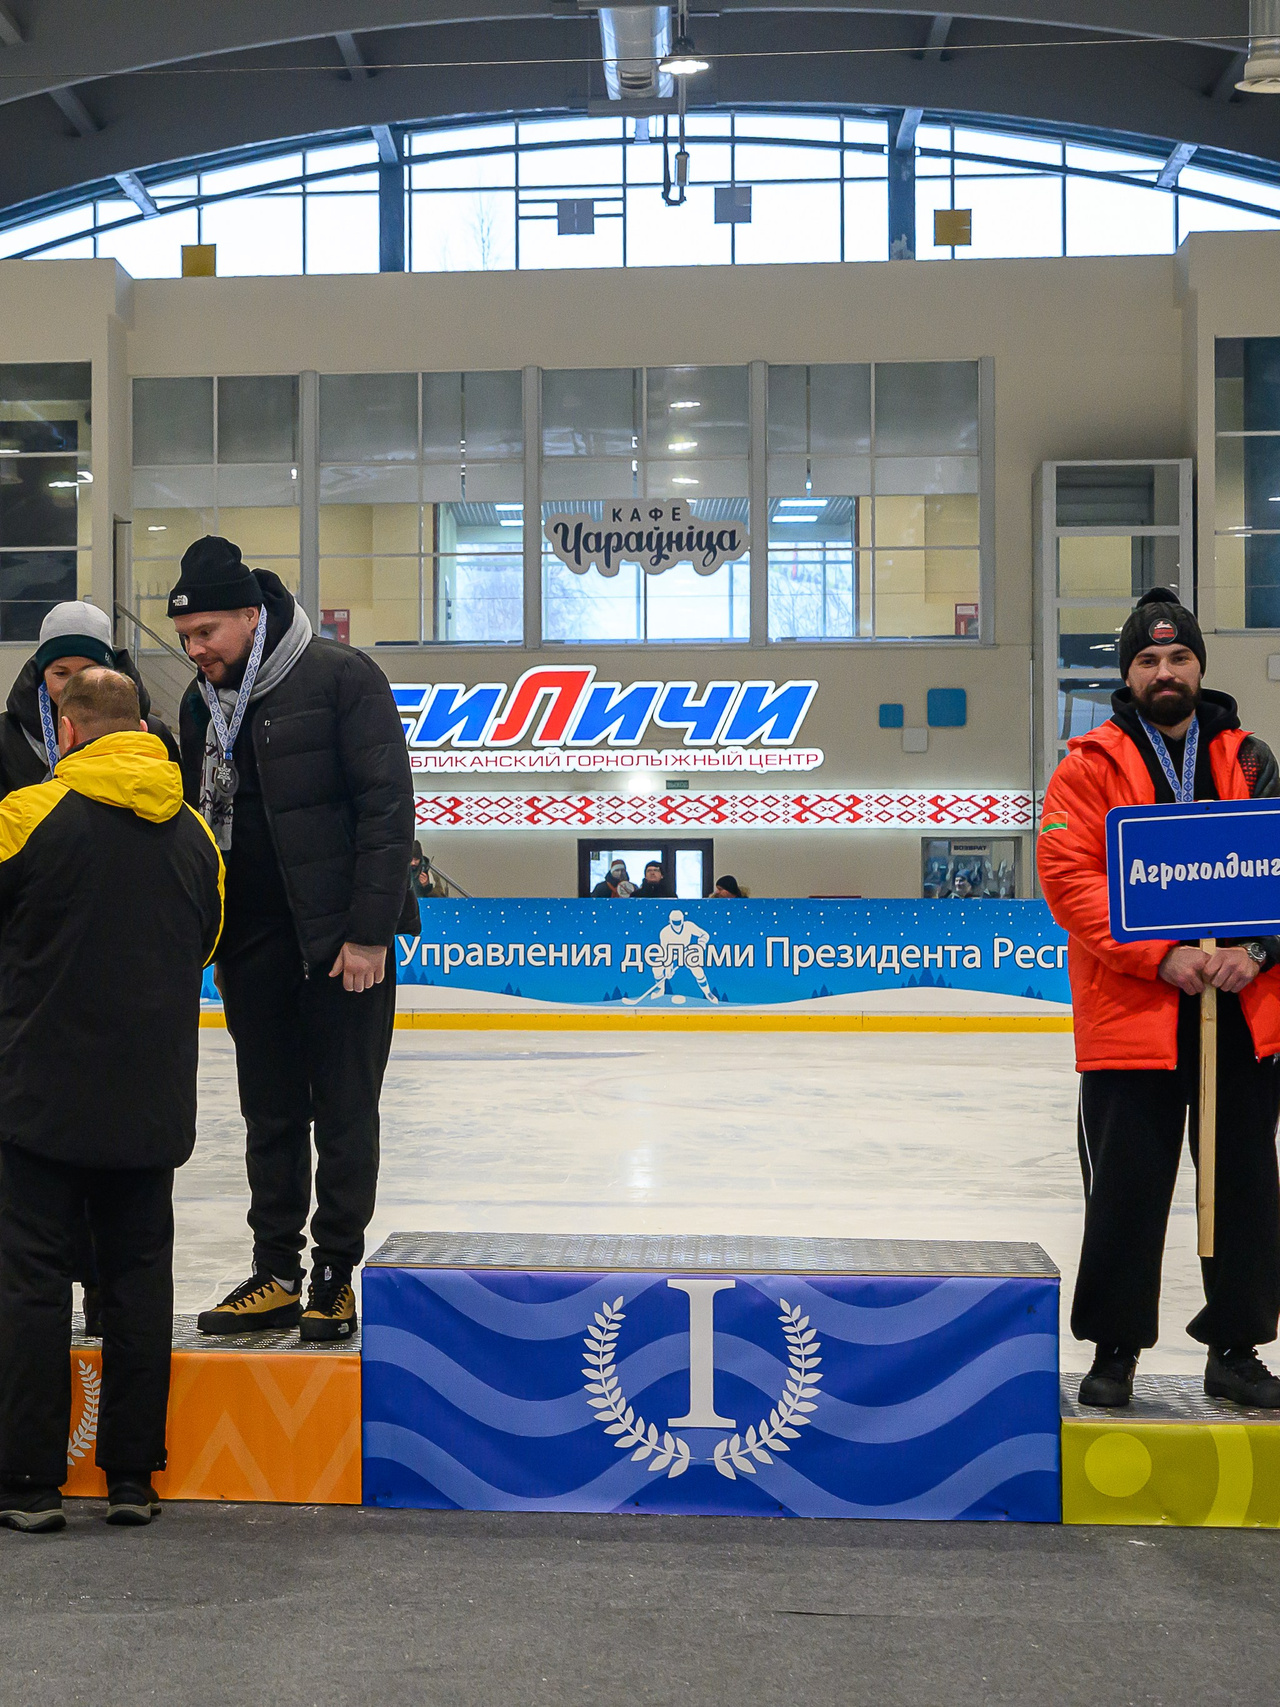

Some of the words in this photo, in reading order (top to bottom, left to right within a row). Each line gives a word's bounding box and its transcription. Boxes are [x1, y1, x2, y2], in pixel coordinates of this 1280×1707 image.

[612, 507, 681, 522] КАФЕ
[553, 522, 741, 569] Чараўніца
[566, 751, 743, 768] ГОРНОЛЫЖНЫЙ
[749, 752, 819, 769] ЦЕНТР
[1129, 852, 1280, 890] Агрохолдинг
[397, 935, 612, 974] Управления
[621, 942, 754, 973] делами
[766, 936, 982, 976] Президента
